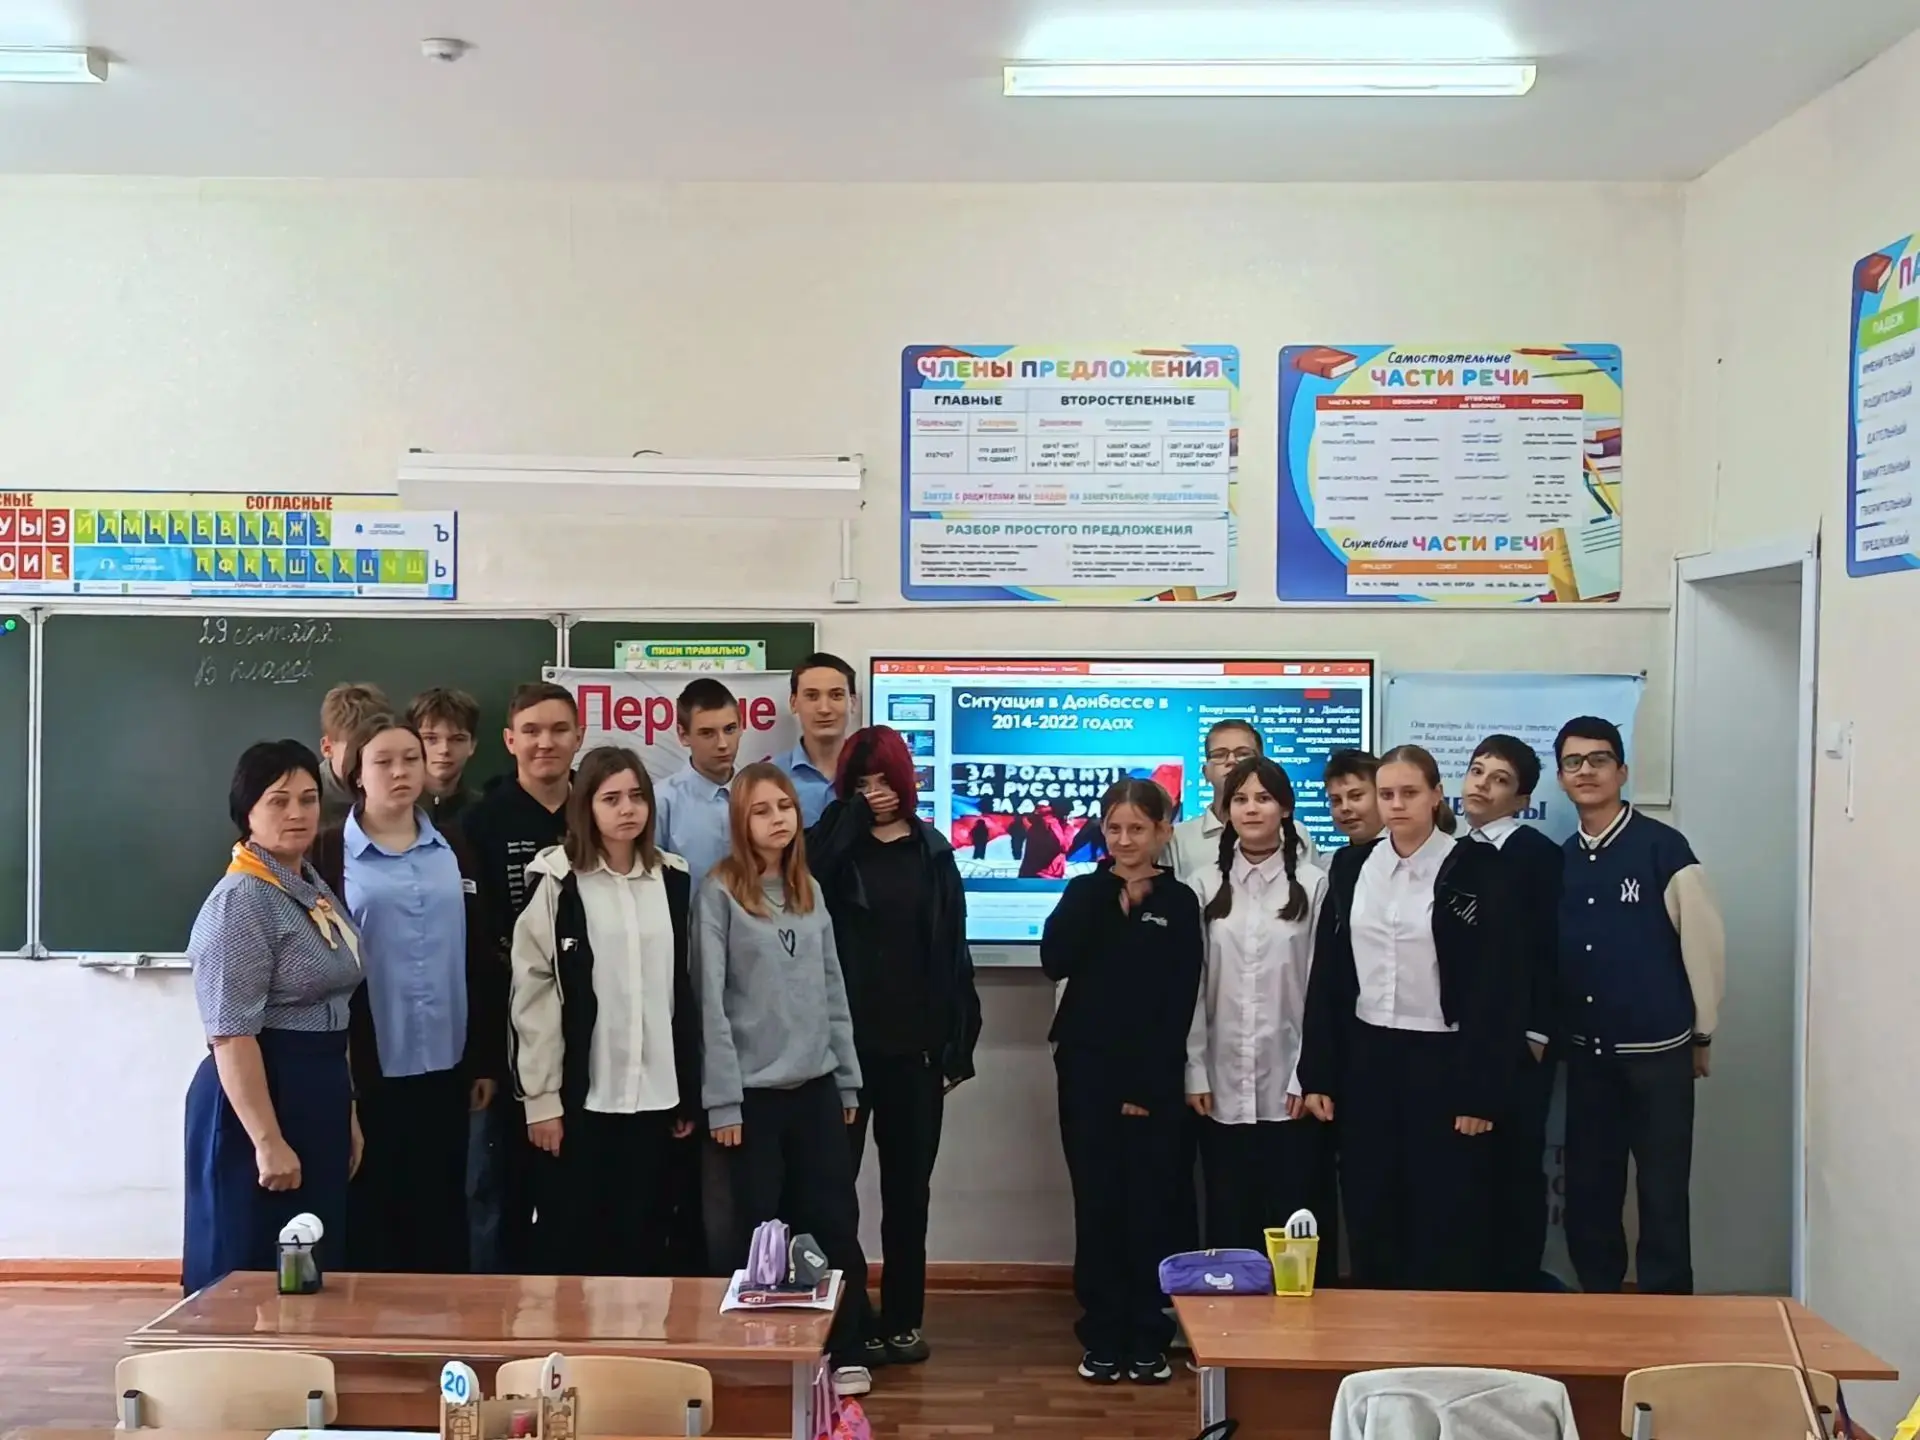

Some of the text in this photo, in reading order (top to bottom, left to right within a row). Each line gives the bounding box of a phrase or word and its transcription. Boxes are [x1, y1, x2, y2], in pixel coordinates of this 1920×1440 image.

[1388, 351, 1511, 364] Самостоятельные
[919, 360, 1220, 381] ЧЛЕНЫ ПРЕДЛОЖЕНИЯ
[1371, 368, 1529, 386] ЧАСТИ РЕЧИ
[934, 395, 1003, 406] ГЛАВНЫЕ
[1061, 395, 1195, 406] ВТОРОСТЕПЕННЫЕ
[0, 493, 34, 507] НЫЕ
[246, 496, 333, 510] СОГЛАСНЫЕ
[21, 516, 42, 536] Ы
[51, 516, 67, 536] Э
[77, 513, 92, 534] Й
[100, 518, 115, 535] Л
[124, 518, 140, 535] М
[150, 518, 162, 535] Н
[173, 519, 184, 534] Р
[196, 520, 208, 535] Б
[218, 520, 230, 535] В
[267, 520, 280, 539] Д
[289, 520, 304, 537] Ж
[433, 523, 450, 542] Ъ
[945, 525, 1193, 537] РАЗБОР ПРОСТОГО ПРЕДЛОЖЕНИЯ
[1341, 535, 1554, 551] Служебные ЧАСТИ РЕЧИ
[23, 552, 39, 573] И
[52, 552, 63, 573] Е
[196, 557, 208, 573] П
[217, 556, 232, 573] Ф
[267, 557, 278, 574] Т
[289, 557, 305, 575] Ш
[338, 558, 349, 574] Х
[361, 558, 375, 578] Ц
[384, 558, 396, 575] Ч
[406, 558, 425, 577] Щ
[435, 559, 447, 578] Ь
[651, 645, 747, 656] ПИШИ ПРАВИЛЬНО
[957, 693, 1169, 712] Ситуация в Донбассе в
[577, 685, 777, 746] Пере
[992, 714, 1134, 730] 2014-2022 годах
[966, 763, 1120, 783] ЗА РОДИНУ!
[966, 782, 994, 797] ЗА
[992, 798, 1014, 814] ЗА
[443, 1370, 467, 1398] 20
